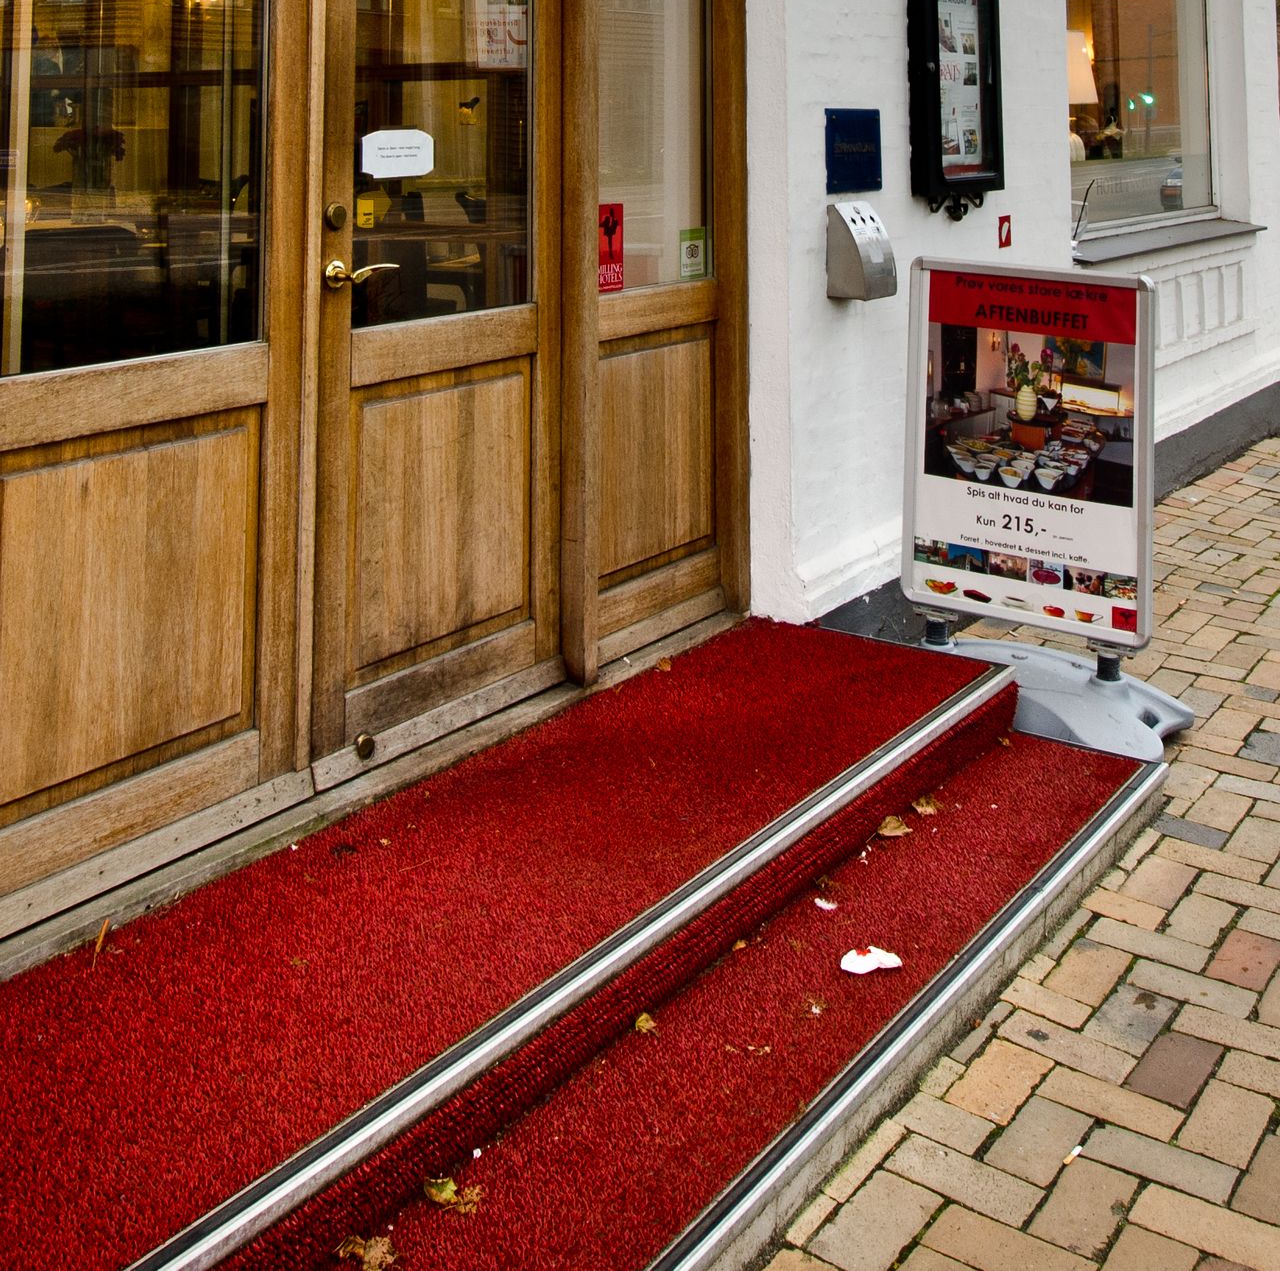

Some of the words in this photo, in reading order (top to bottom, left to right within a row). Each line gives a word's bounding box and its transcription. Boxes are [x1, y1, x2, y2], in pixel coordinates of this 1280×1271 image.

[955, 275, 985, 291] Prøv
[988, 280, 1024, 294] vores
[1028, 283, 1061, 298] store
[975, 304, 1089, 330] AFTENBUFFET
[966, 486, 986, 499] Spis
[988, 490, 1001, 501] alt
[1003, 493, 1029, 506] hvad
[1032, 497, 1045, 508] du
[1048, 500, 1068, 513] kan
[1070, 503, 1085, 515] for
[976, 514, 996, 527] Kun
[1002, 513, 1047, 537] 215,-
[985, 538, 1017, 551] hovedret
[1025, 546, 1050, 557] dessert
